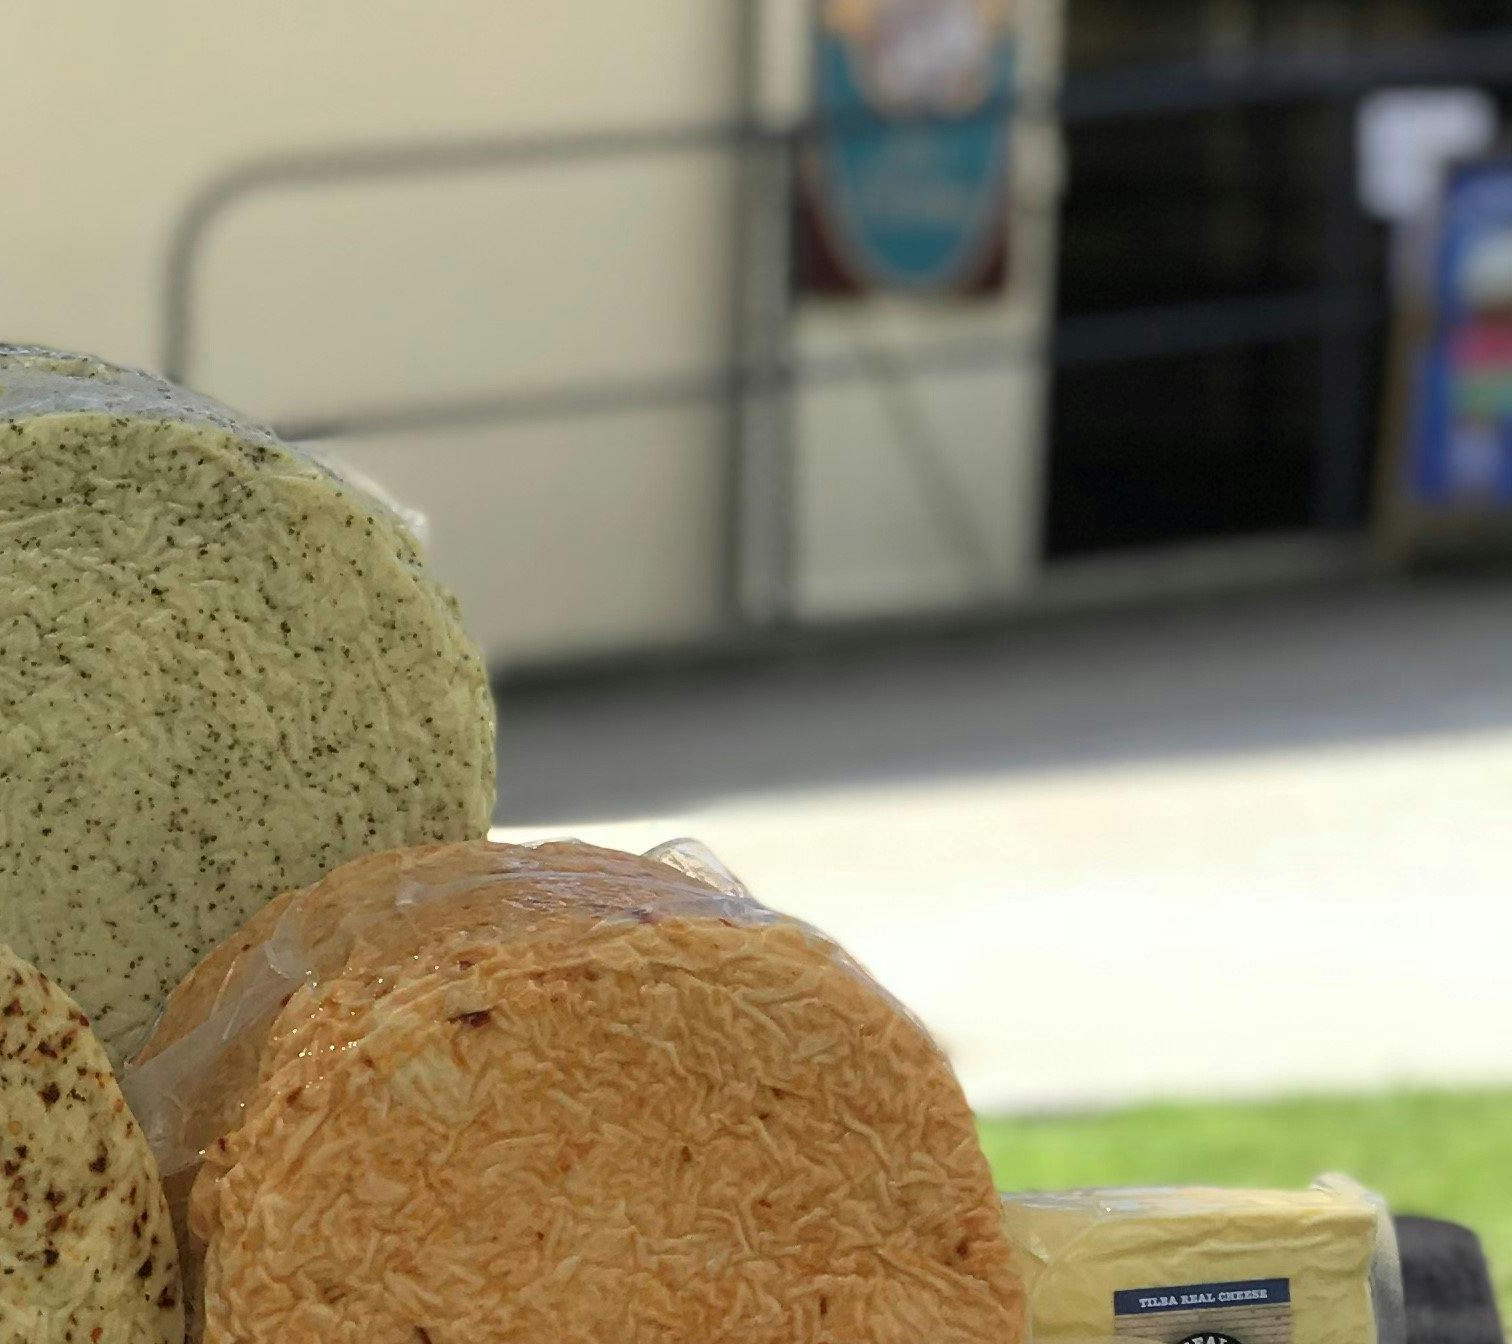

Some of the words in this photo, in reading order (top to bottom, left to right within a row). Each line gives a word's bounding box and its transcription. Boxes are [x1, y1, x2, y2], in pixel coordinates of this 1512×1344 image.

[1139, 1296, 1177, 1308] TILBA
[1181, 1293, 1216, 1304] REAL
[1218, 1288, 1268, 1301] CHEESE
